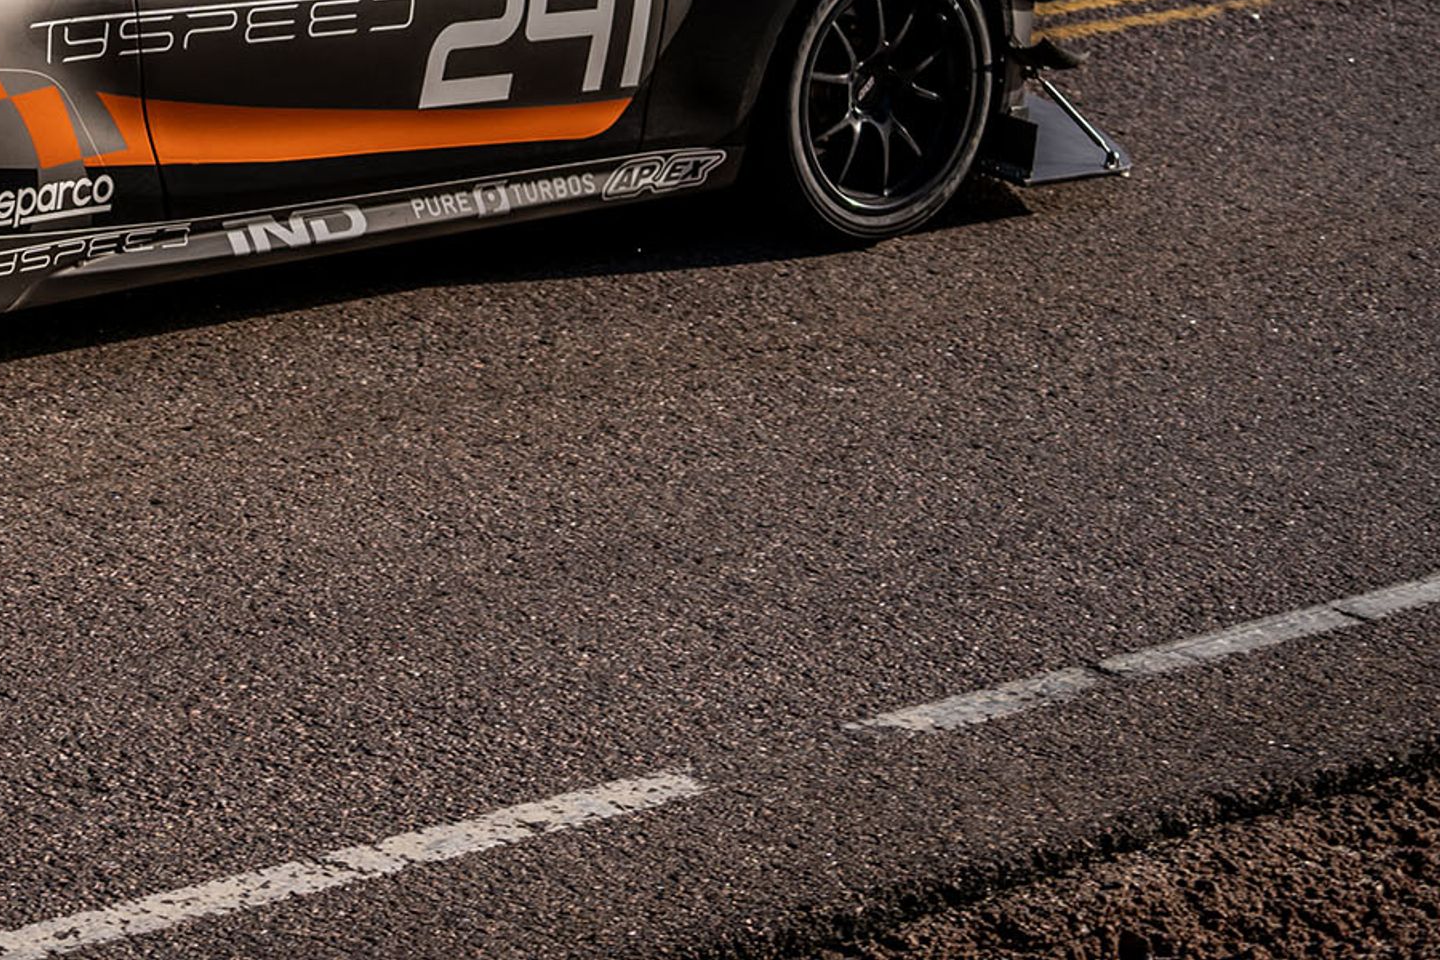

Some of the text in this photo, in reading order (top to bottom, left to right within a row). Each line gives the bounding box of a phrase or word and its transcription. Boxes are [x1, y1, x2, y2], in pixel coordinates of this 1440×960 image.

[410, 171, 597, 220] PURE TURBOS
[609, 150, 720, 196] APEX
